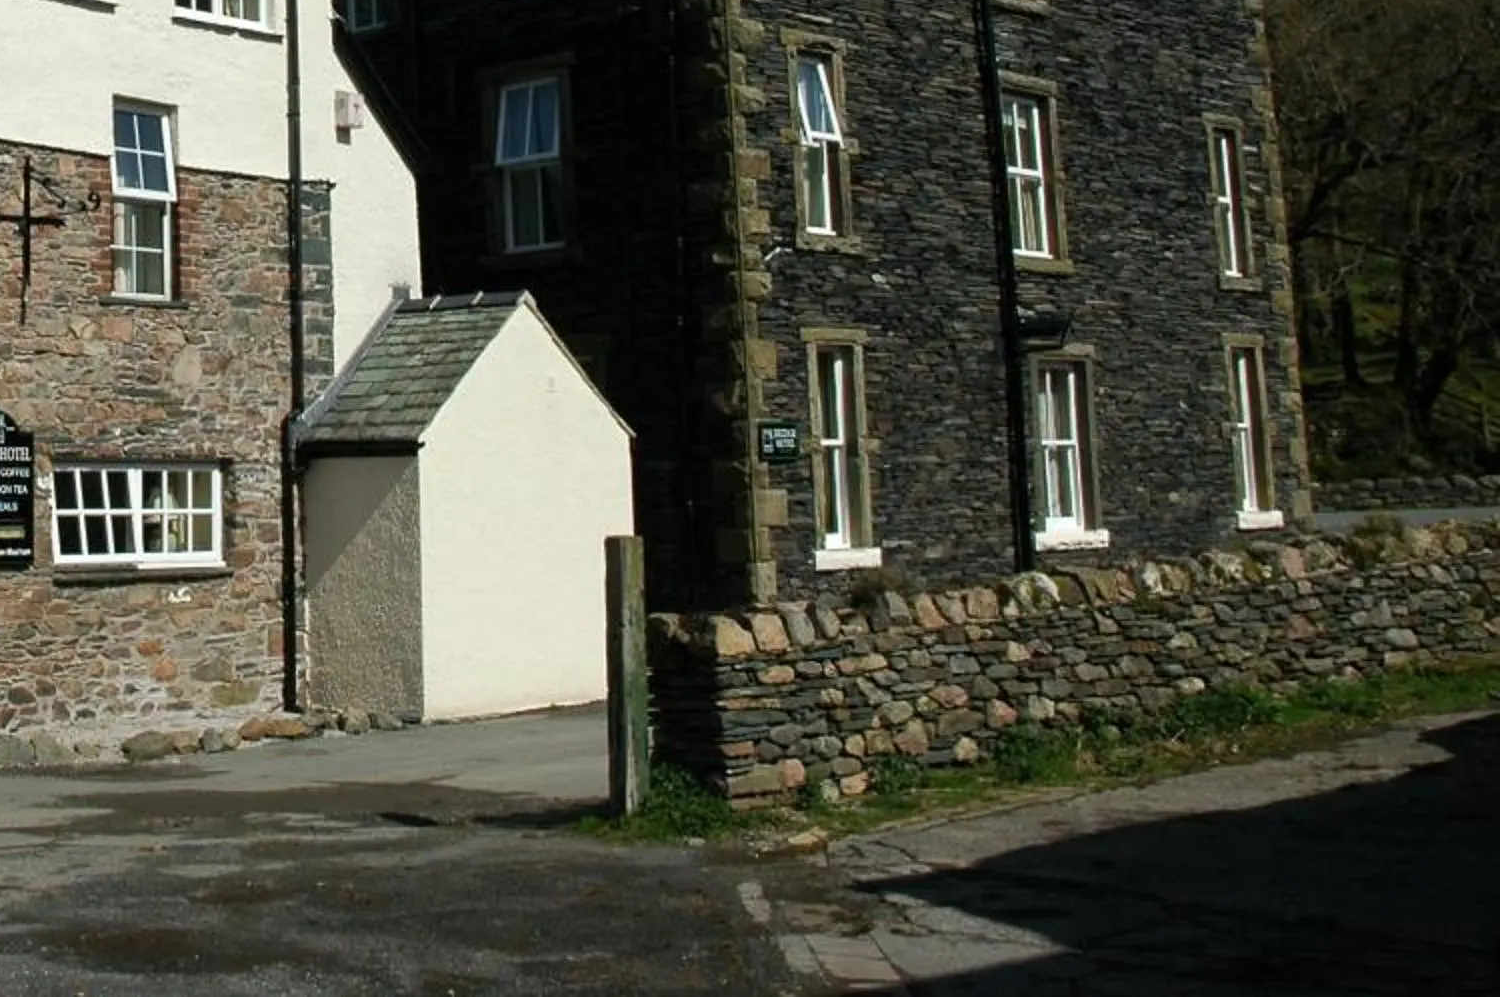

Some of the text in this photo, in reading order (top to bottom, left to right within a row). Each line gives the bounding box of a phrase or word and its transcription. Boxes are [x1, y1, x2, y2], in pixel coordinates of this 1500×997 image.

[0, 446, 31, 462] HOTEL
[0, 467, 31, 478] COFFEE
[13, 484, 29, 495] TEA
